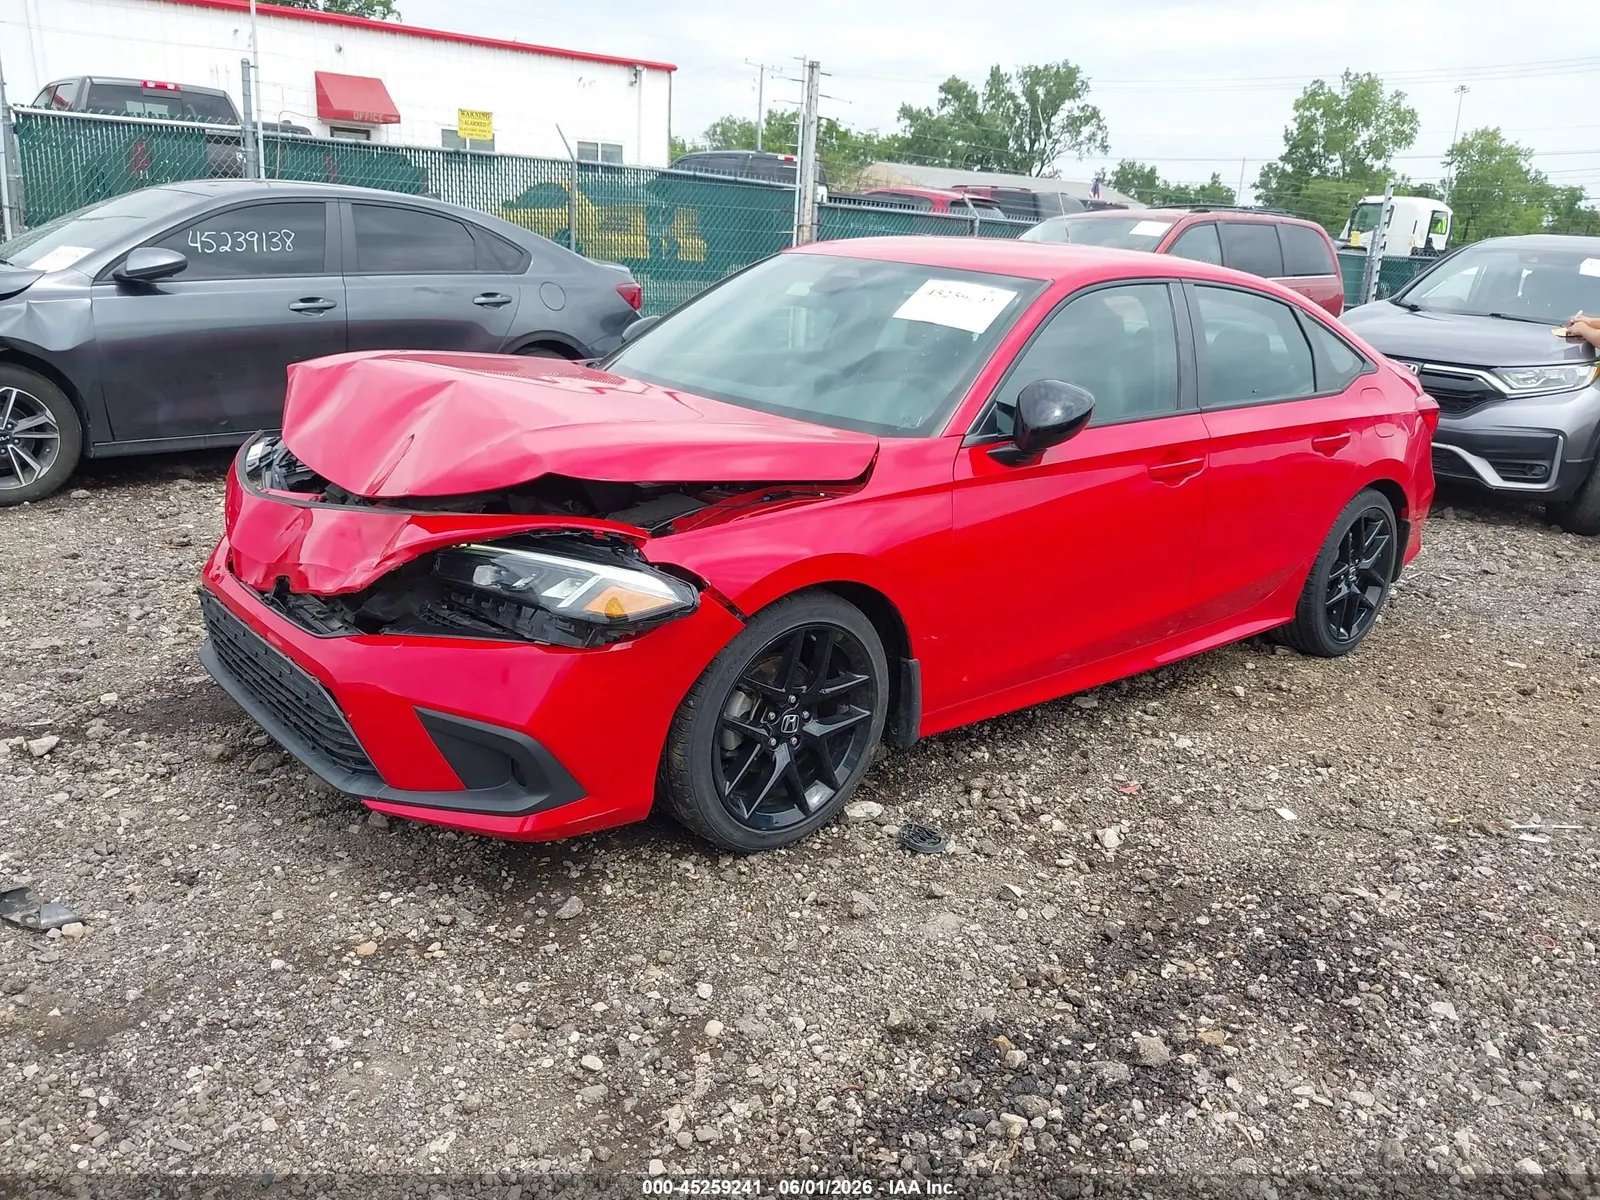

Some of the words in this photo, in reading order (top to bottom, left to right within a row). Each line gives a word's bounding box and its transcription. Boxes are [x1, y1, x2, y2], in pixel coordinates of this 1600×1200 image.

[353, 111, 383, 122] OFFICE
[460, 109, 490, 119] WARNING
[187, 229, 295, 253] 45239138
